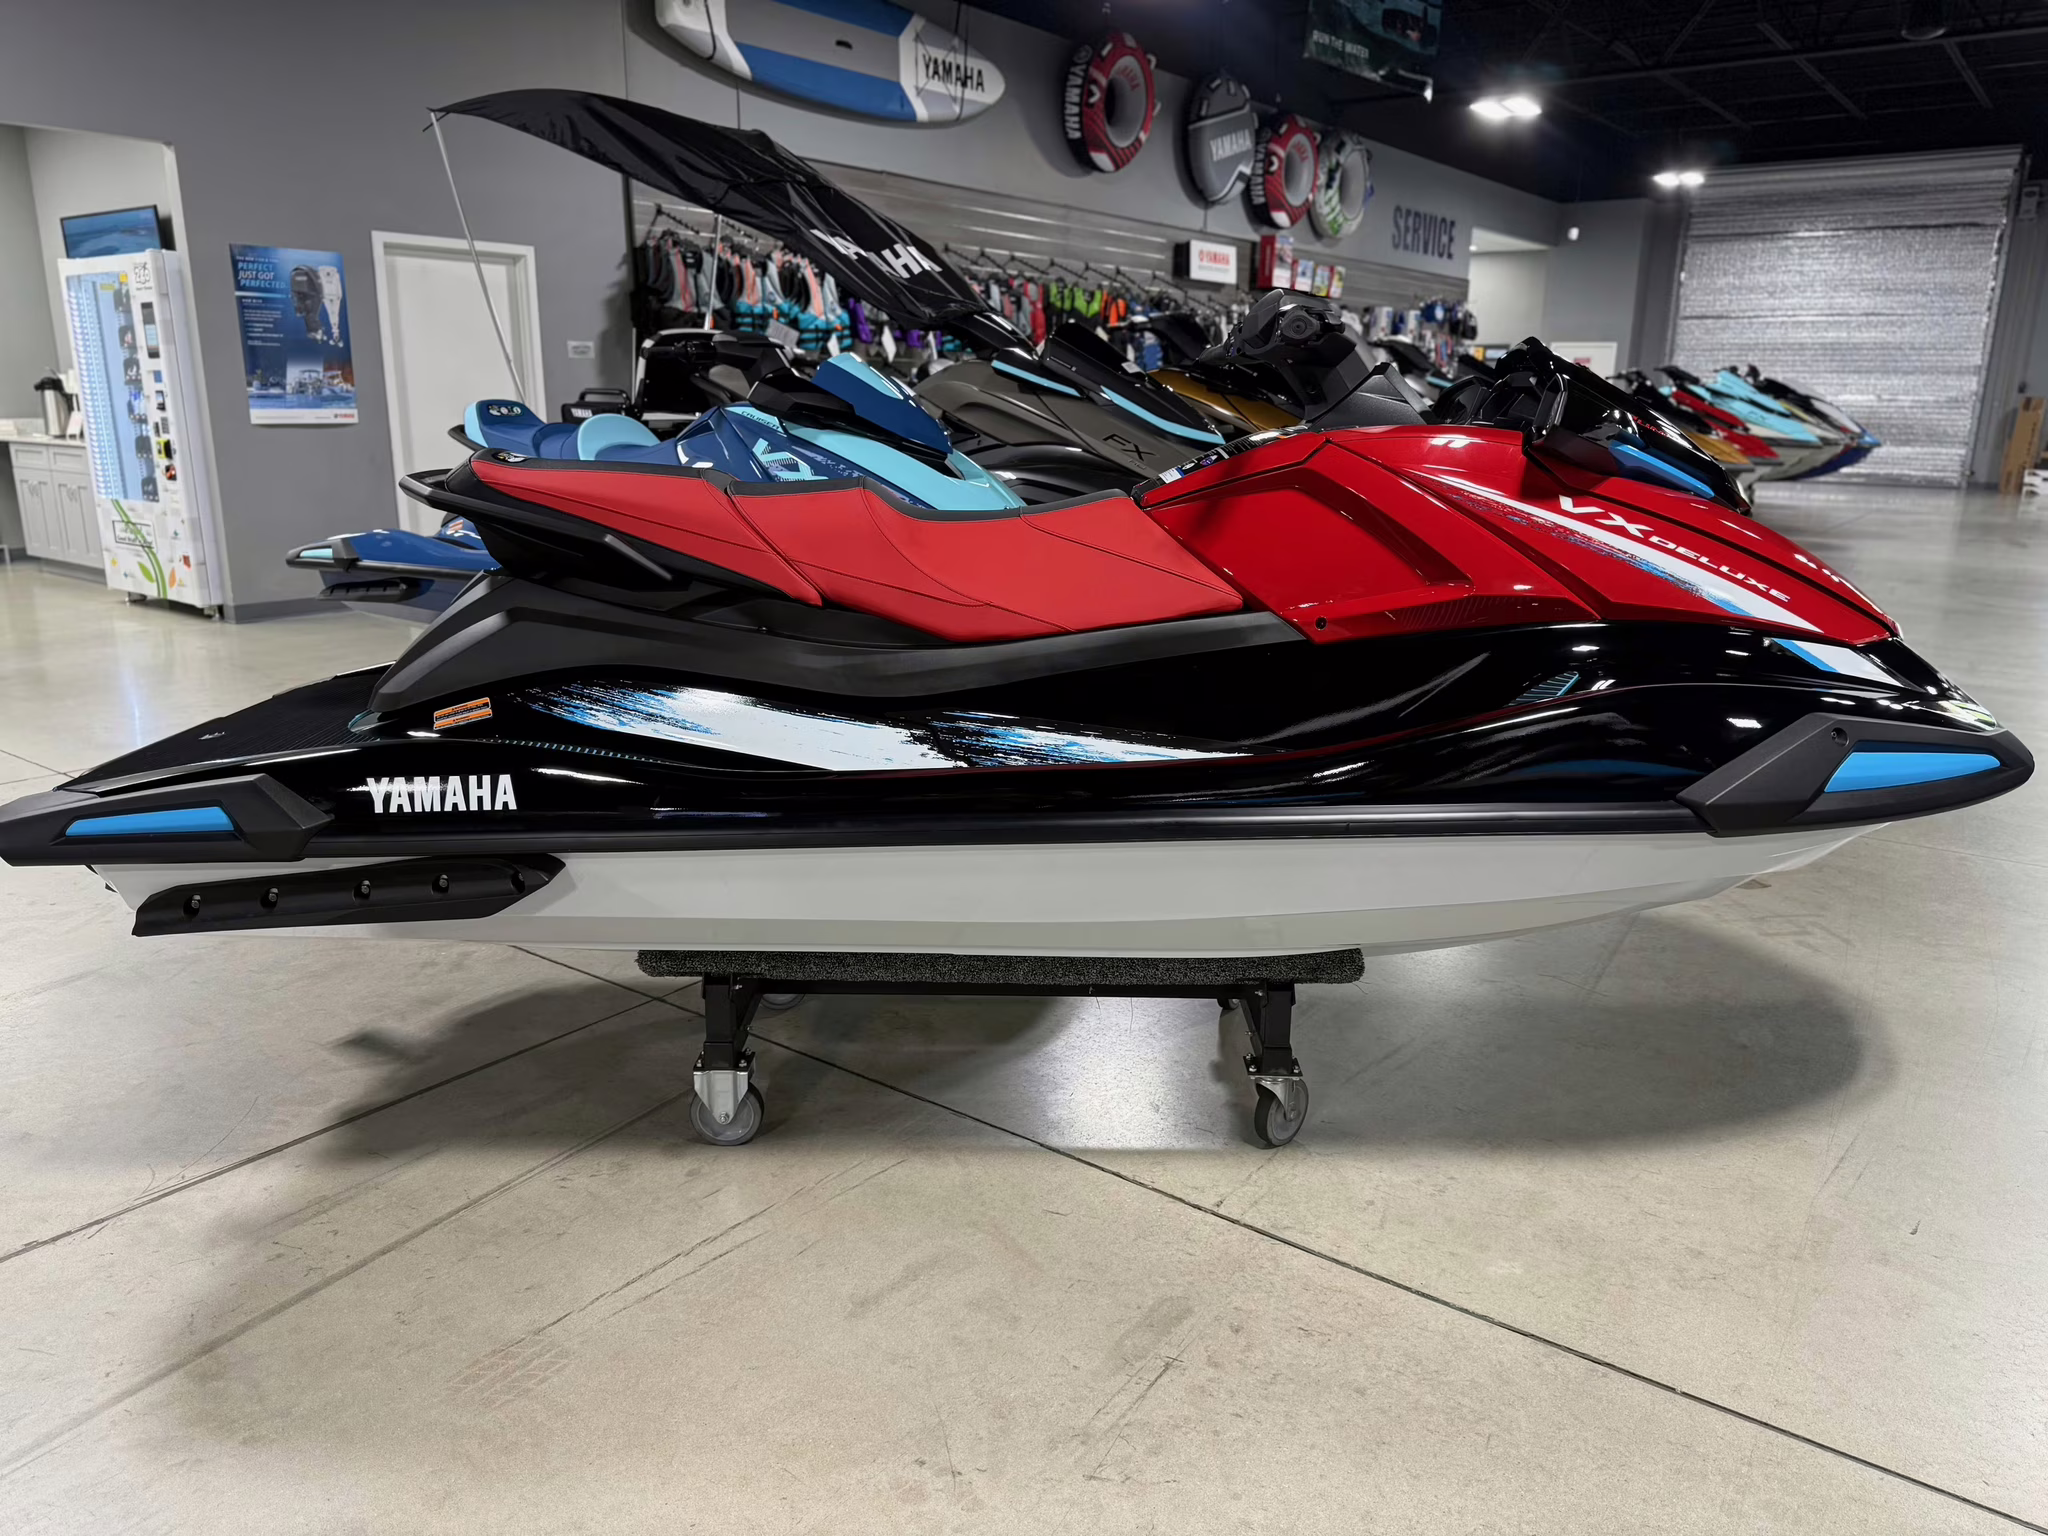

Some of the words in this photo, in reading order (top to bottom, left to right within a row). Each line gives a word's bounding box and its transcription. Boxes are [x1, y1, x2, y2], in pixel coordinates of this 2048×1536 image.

[922, 53, 985, 93] YAMAHA
[1064, 64, 1087, 139] YAMAHA
[1210, 129, 1252, 162] YAMAHA
[1392, 204, 1456, 261] SERVICE
[238, 261, 274, 272] PERFECT
[809, 229, 943, 279] YAAHA
[1203, 250, 1230, 267] YAMAHA
[237, 270, 256, 280] JUST
[257, 271, 275, 281] GOT
[741, 410, 780, 430] CRUISER
[1102, 433, 1157, 462] FX
[1559, 495, 1654, 538] VX
[1648, 535, 1791, 602] DELUXE
[366, 774, 518, 814] YAMAHA
